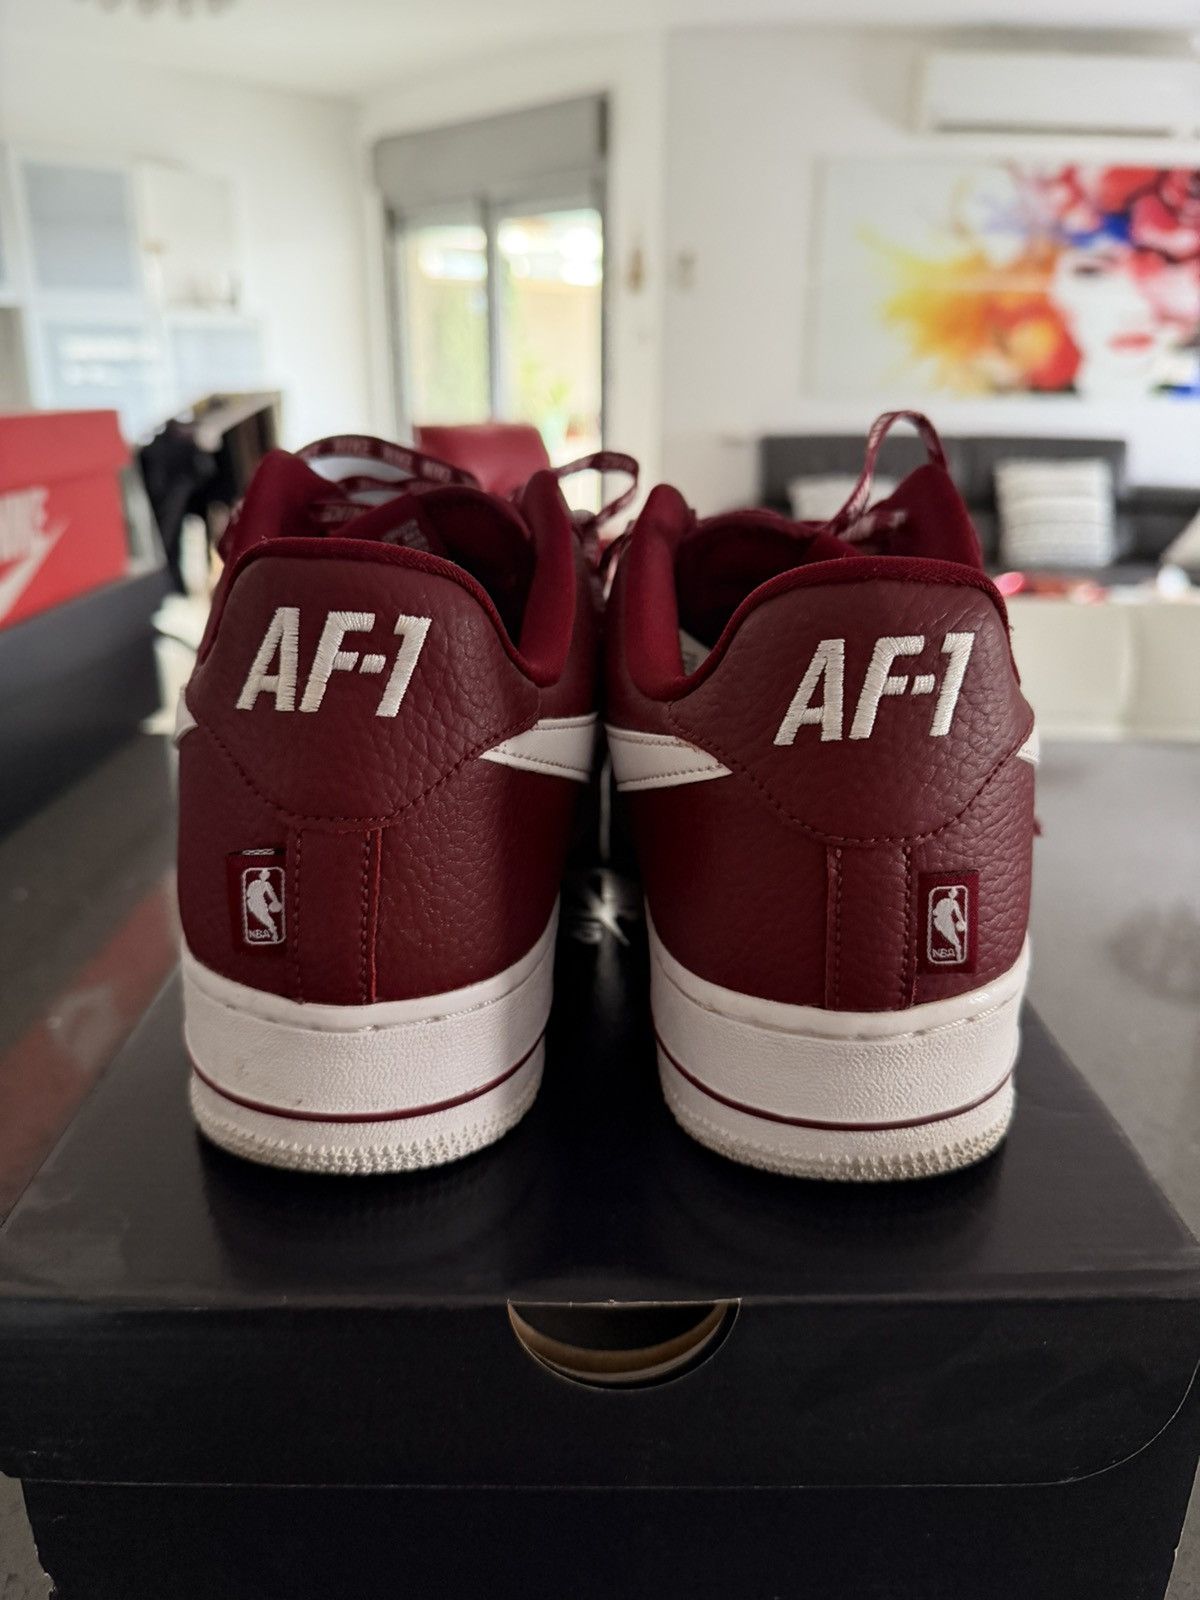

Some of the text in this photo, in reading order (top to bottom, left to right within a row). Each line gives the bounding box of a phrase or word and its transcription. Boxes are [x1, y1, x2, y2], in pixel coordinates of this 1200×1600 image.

[236, 607, 432, 717] AF-1
[773, 632, 975, 745] AF-1
[249, 929, 271, 939] NBA
[932, 948, 956, 958] NBA
